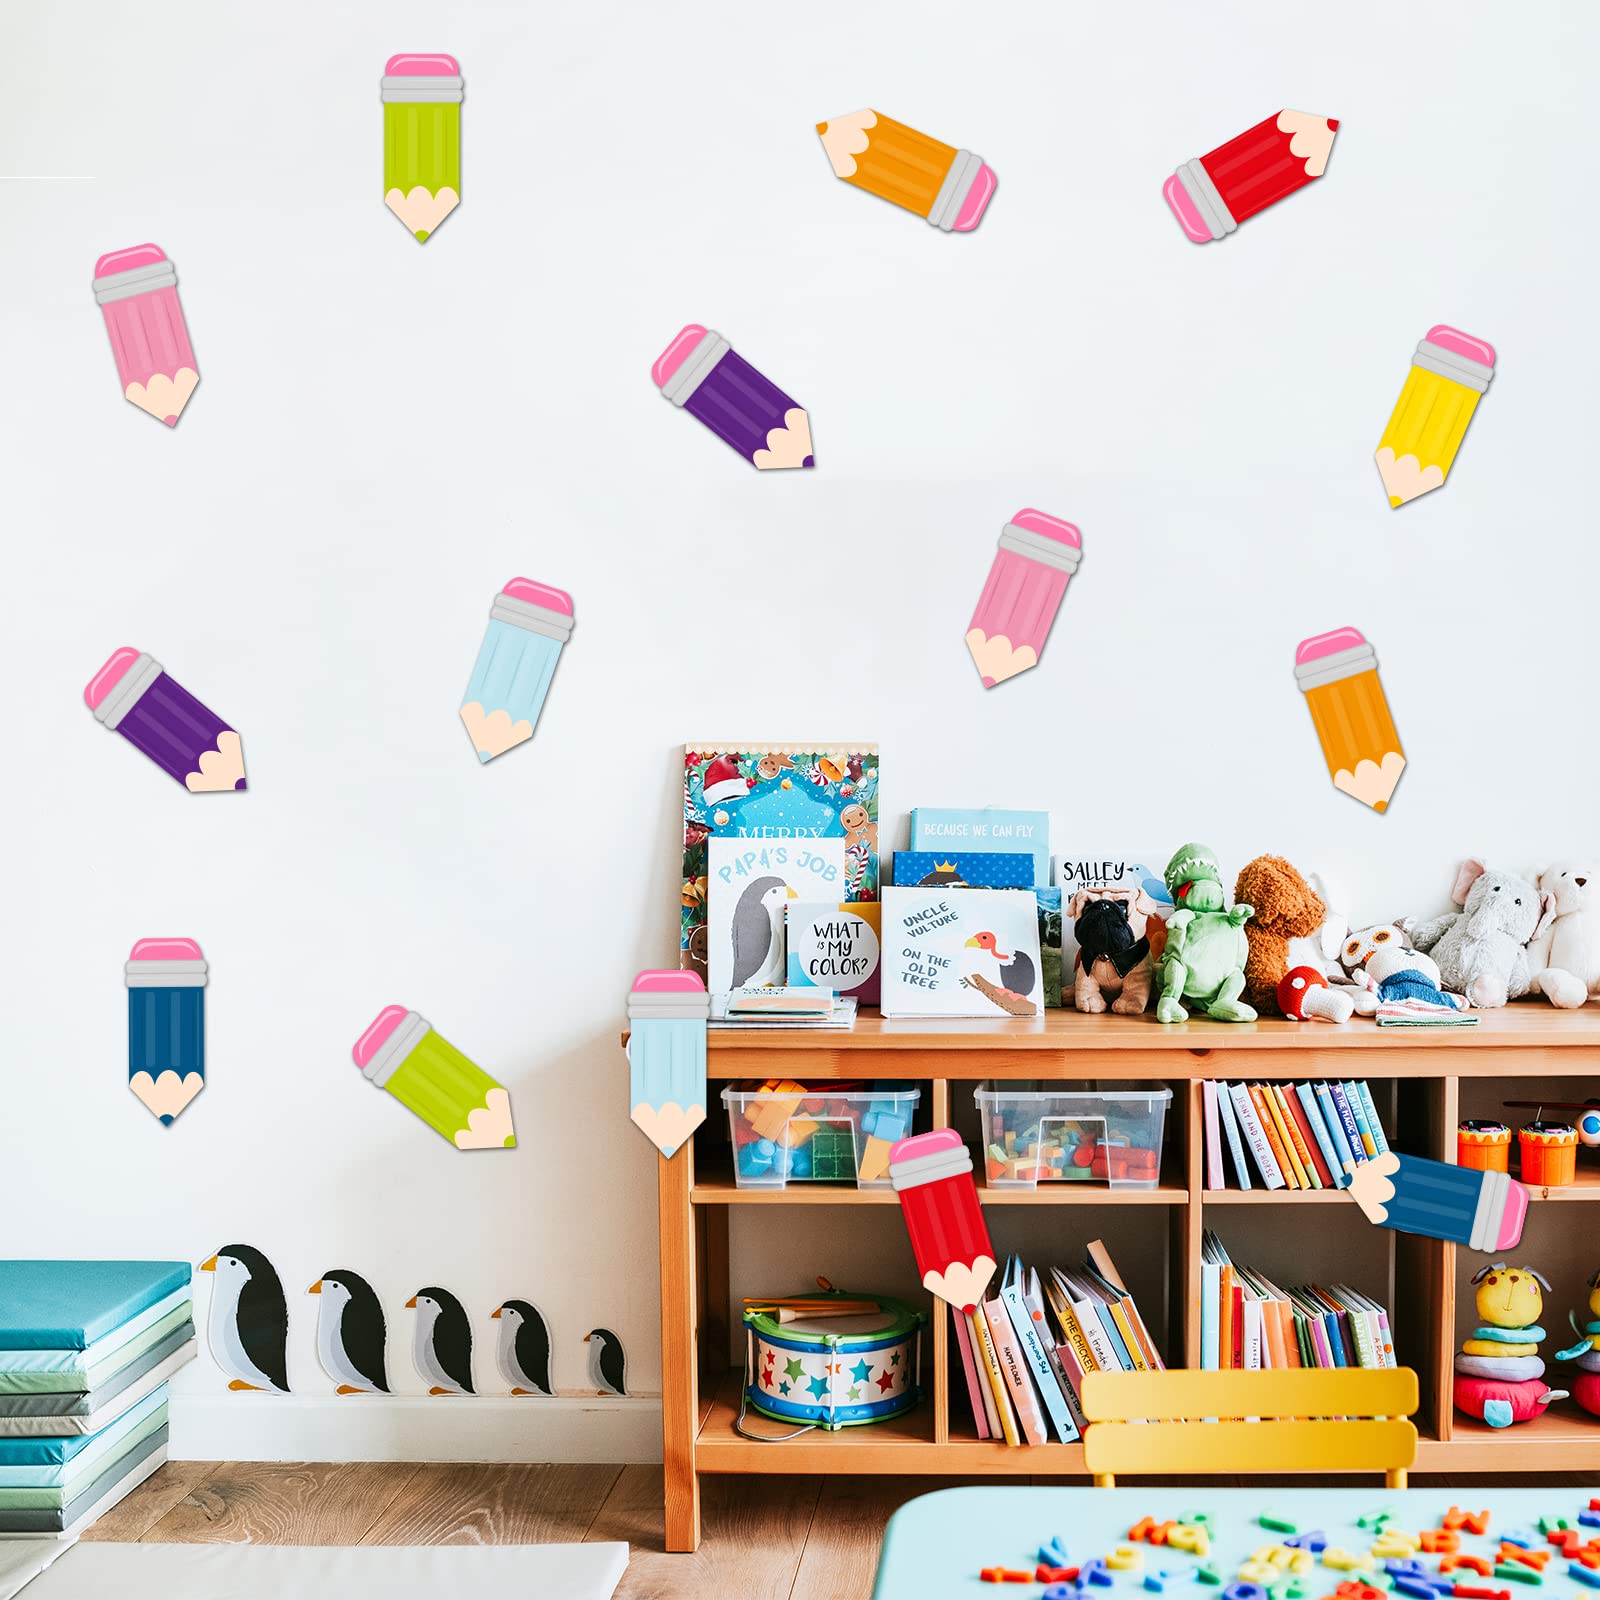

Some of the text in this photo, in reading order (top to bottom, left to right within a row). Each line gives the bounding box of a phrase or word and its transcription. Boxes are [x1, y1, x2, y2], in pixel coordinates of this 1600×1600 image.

[924, 824, 1034, 837] BECAUSE WE CAN FLY
[718, 847, 837, 884] PAPA'S JOB
[1063, 862, 1124, 881] SALLEY
[903, 901, 949, 927] UNCLE
[813, 922, 863, 938] WHAT
[907, 911, 959, 938] VULTURE
[828, 940, 852, 957] MY
[902, 948, 952, 968] ON THE
[809, 958, 868, 976] COLOR?
[908, 962, 937, 977] OLD
[901, 971, 939, 990] TREE
[1337, 1096, 1346, 1110] THE
[1341, 1108, 1355, 1134] MAGIC
[1235, 1096, 1251, 1119] JENNY
[1247, 1121, 1259, 1137] AND
[1254, 1138, 1265, 1153] THE
[1260, 1155, 1276, 1178] HORSE
[1065, 1314, 1096, 1373] THE CHICKEN
